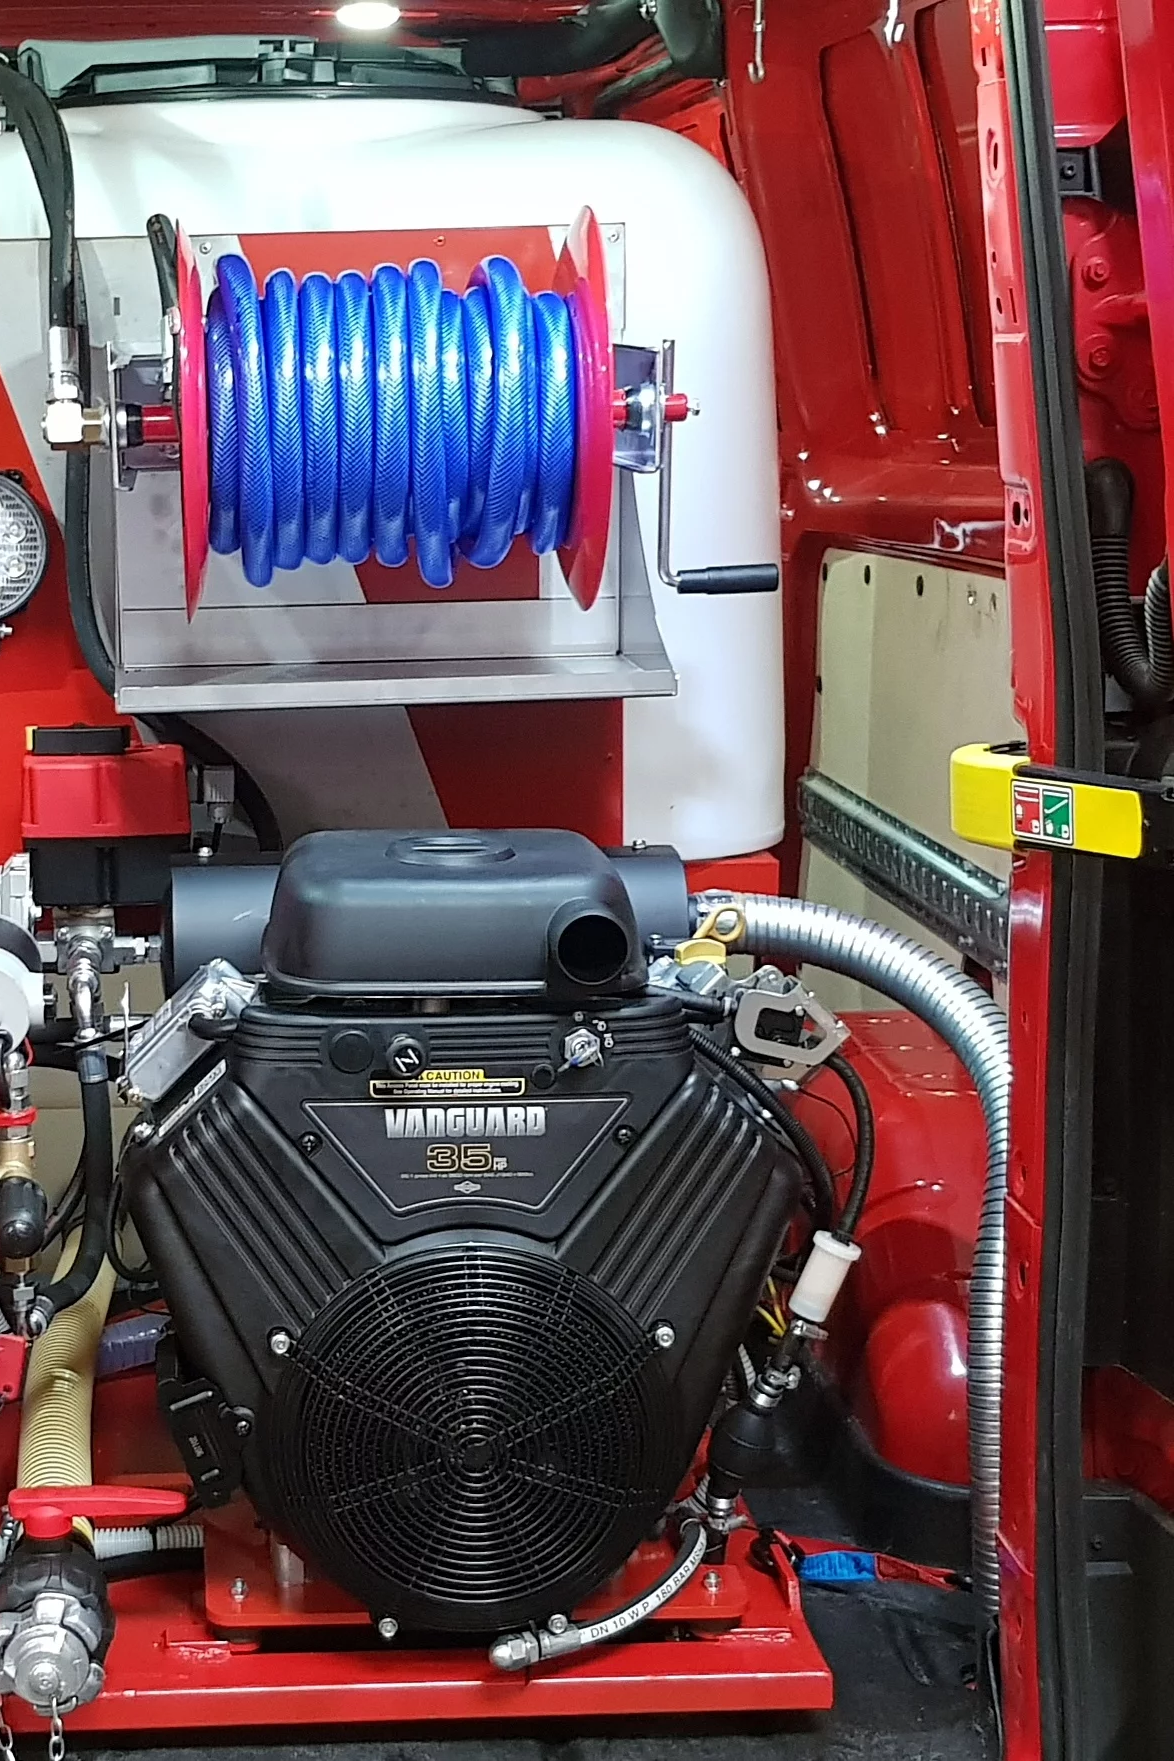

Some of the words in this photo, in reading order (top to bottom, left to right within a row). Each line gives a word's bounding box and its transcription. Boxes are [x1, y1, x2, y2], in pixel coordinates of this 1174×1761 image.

[426, 1071, 480, 1081] CAUTION
[384, 1106, 546, 1138] VANGUARD
[427, 1143, 492, 1172] 35
[493, 1160, 508, 1171] HP
[590, 1624, 609, 1639] DN
[613, 1616, 627, 1629] 10
[655, 1584, 673, 1602] 180
[672, 1565, 691, 1587] BAR
